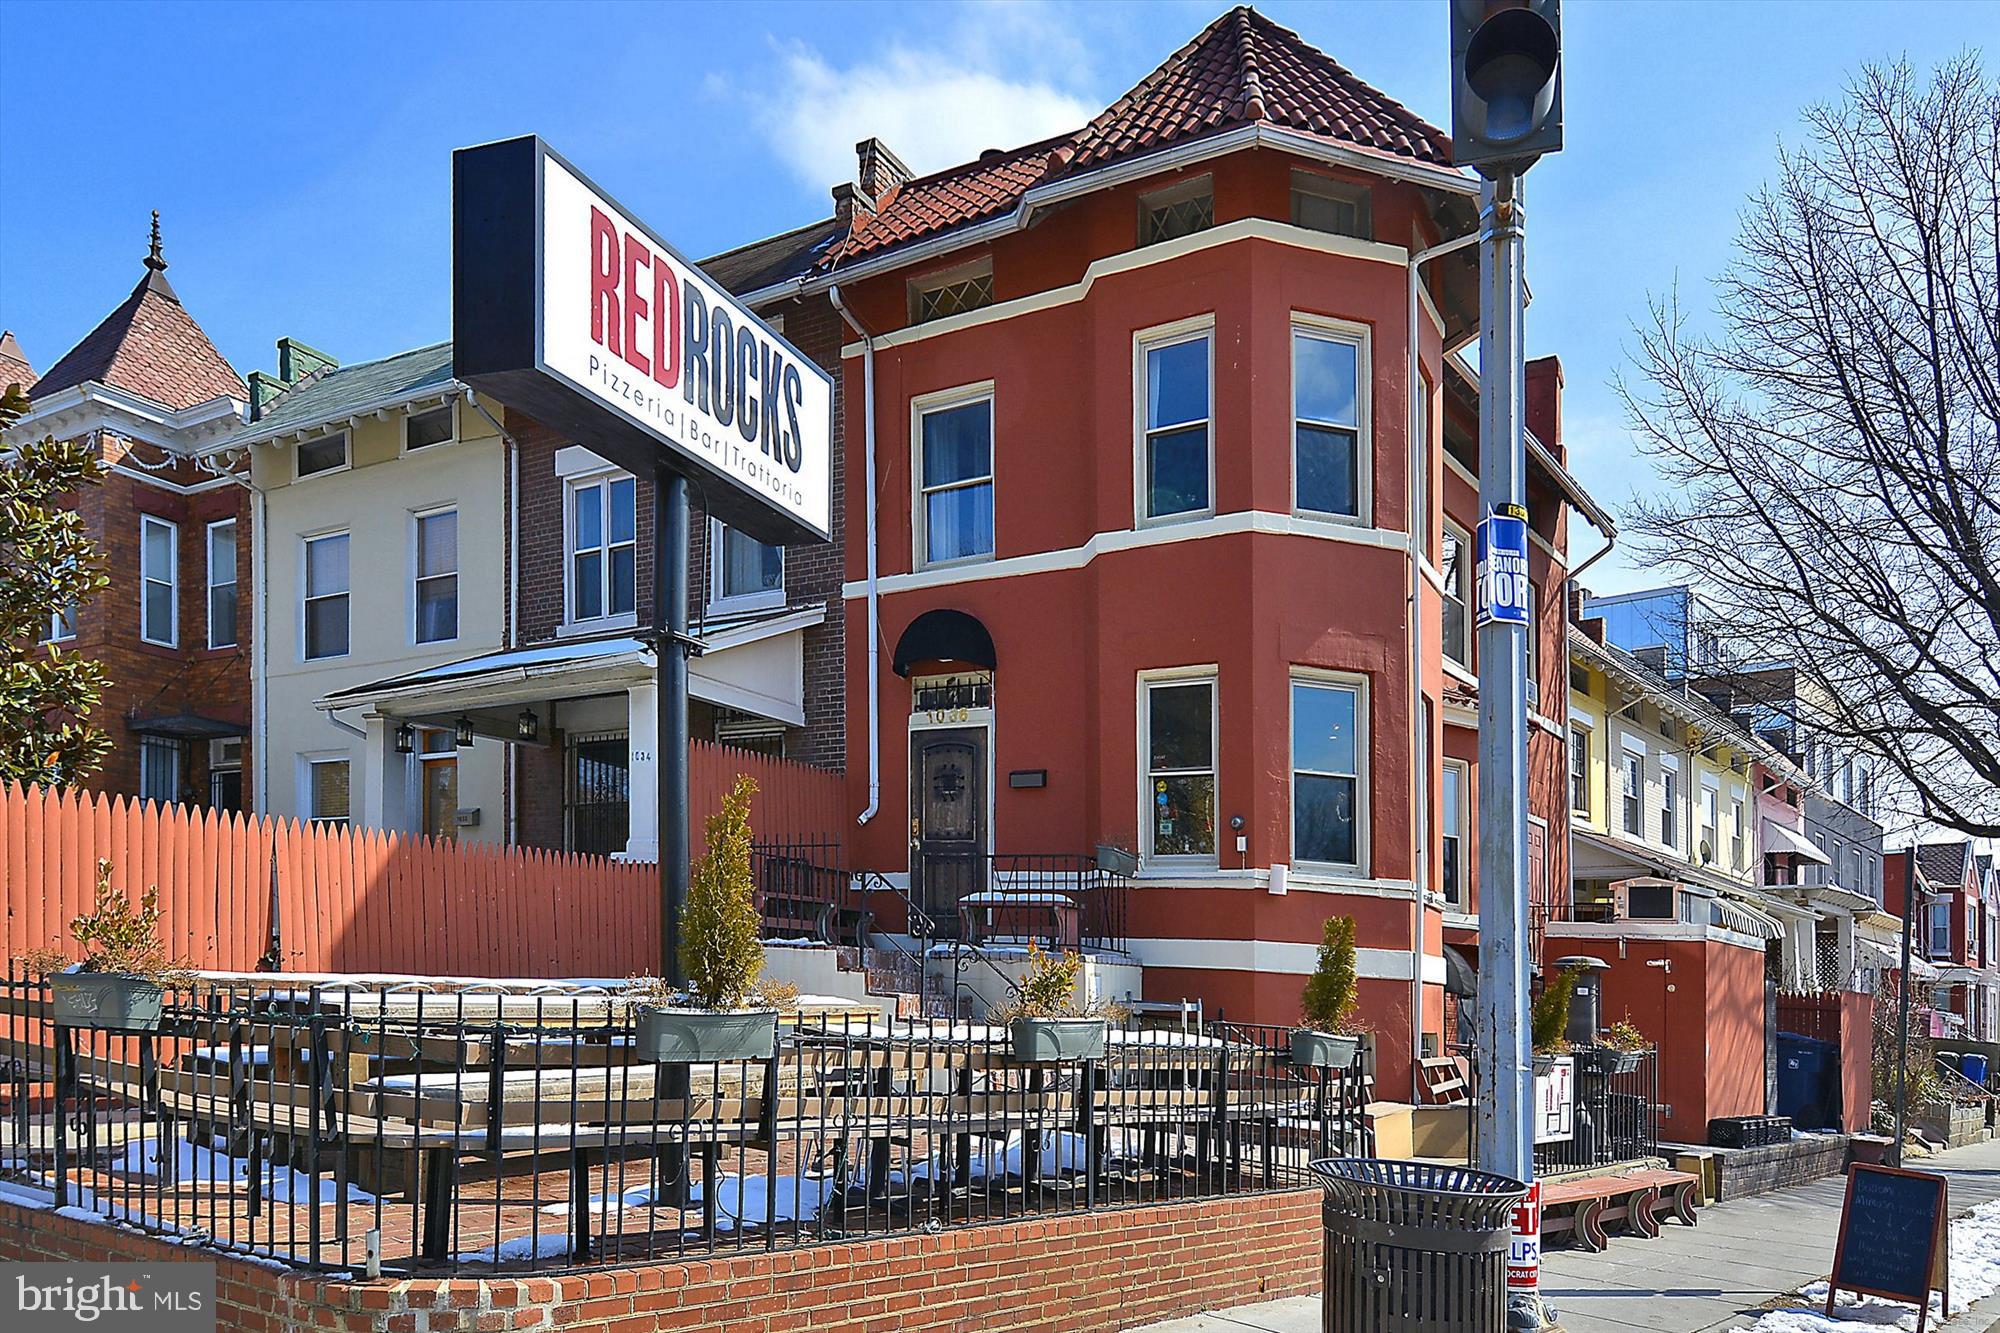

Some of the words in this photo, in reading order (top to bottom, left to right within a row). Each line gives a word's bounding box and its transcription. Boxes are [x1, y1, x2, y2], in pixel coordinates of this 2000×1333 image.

[589, 354, 675, 427] Pizzeria
[690, 418, 720, 454] Bar
[732, 445, 802, 506] Trattoria
[927, 707, 968, 724] 1036
[1508, 1242, 1536, 1260] LPS
